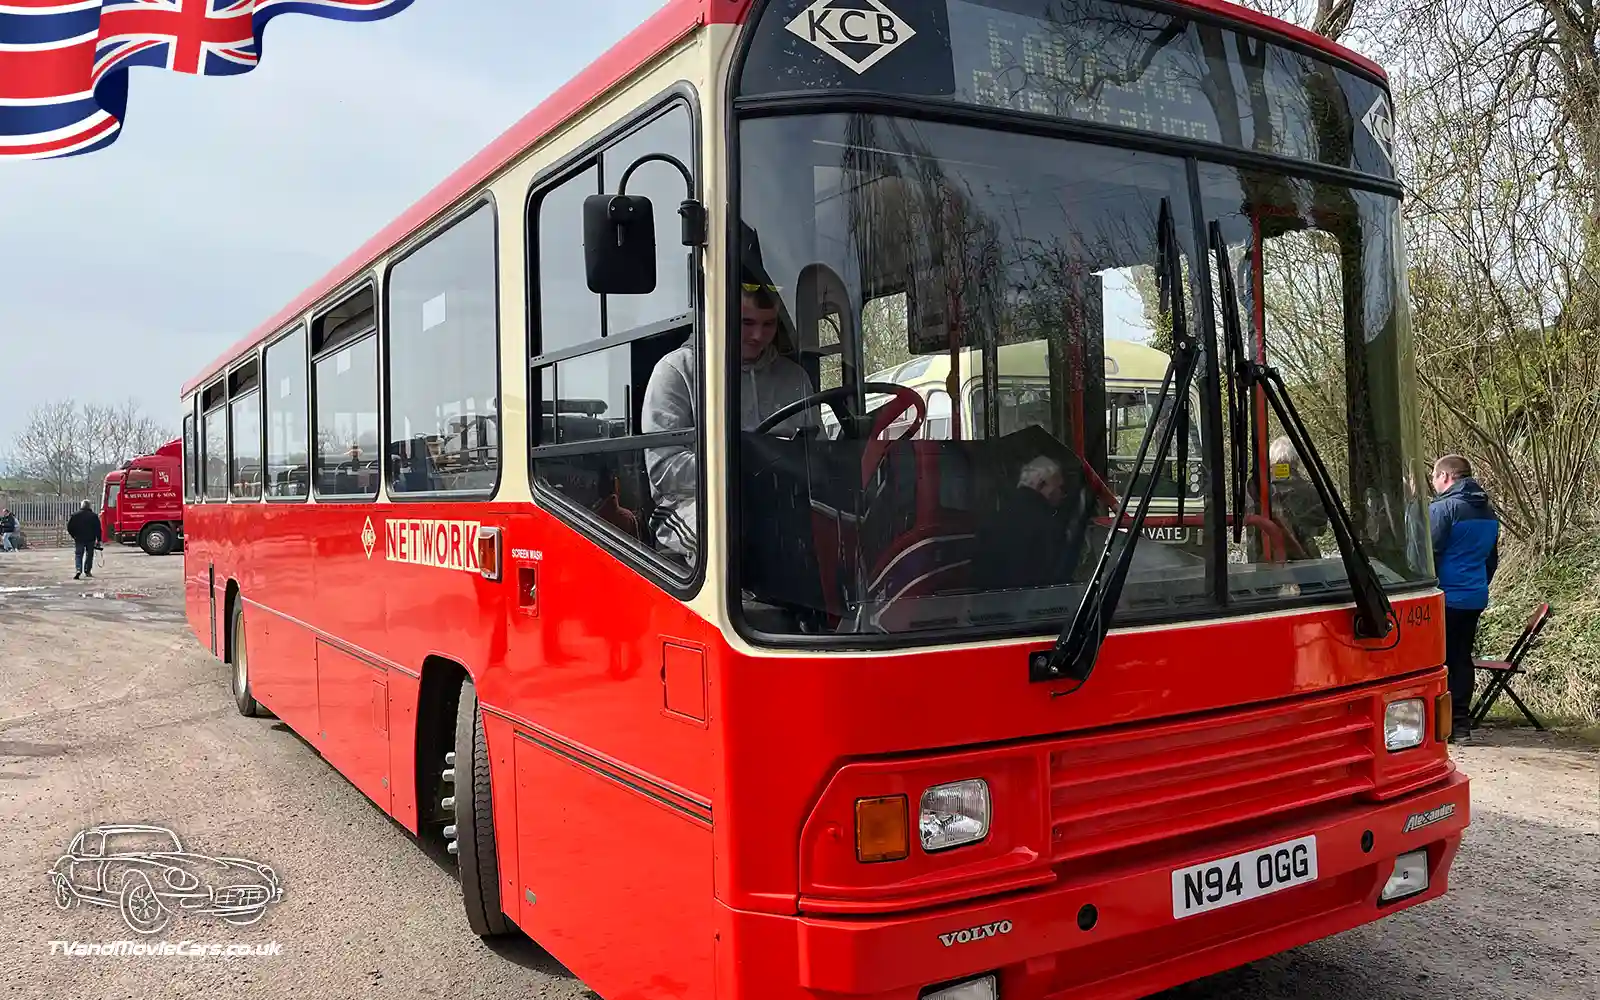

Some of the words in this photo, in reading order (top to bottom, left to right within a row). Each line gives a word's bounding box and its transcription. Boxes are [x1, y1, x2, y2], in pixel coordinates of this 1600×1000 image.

[807, 9, 898, 44] KCB
[386, 522, 479, 568] NETWORK
[1142, 527, 1182, 540] VATE
[1407, 604, 1431, 626] 494
[1403, 803, 1456, 832] Alexander
[1184, 861, 1243, 910] N94
[1256, 844, 1309, 889] OGG
[938, 920, 1013, 947] VOLVO
